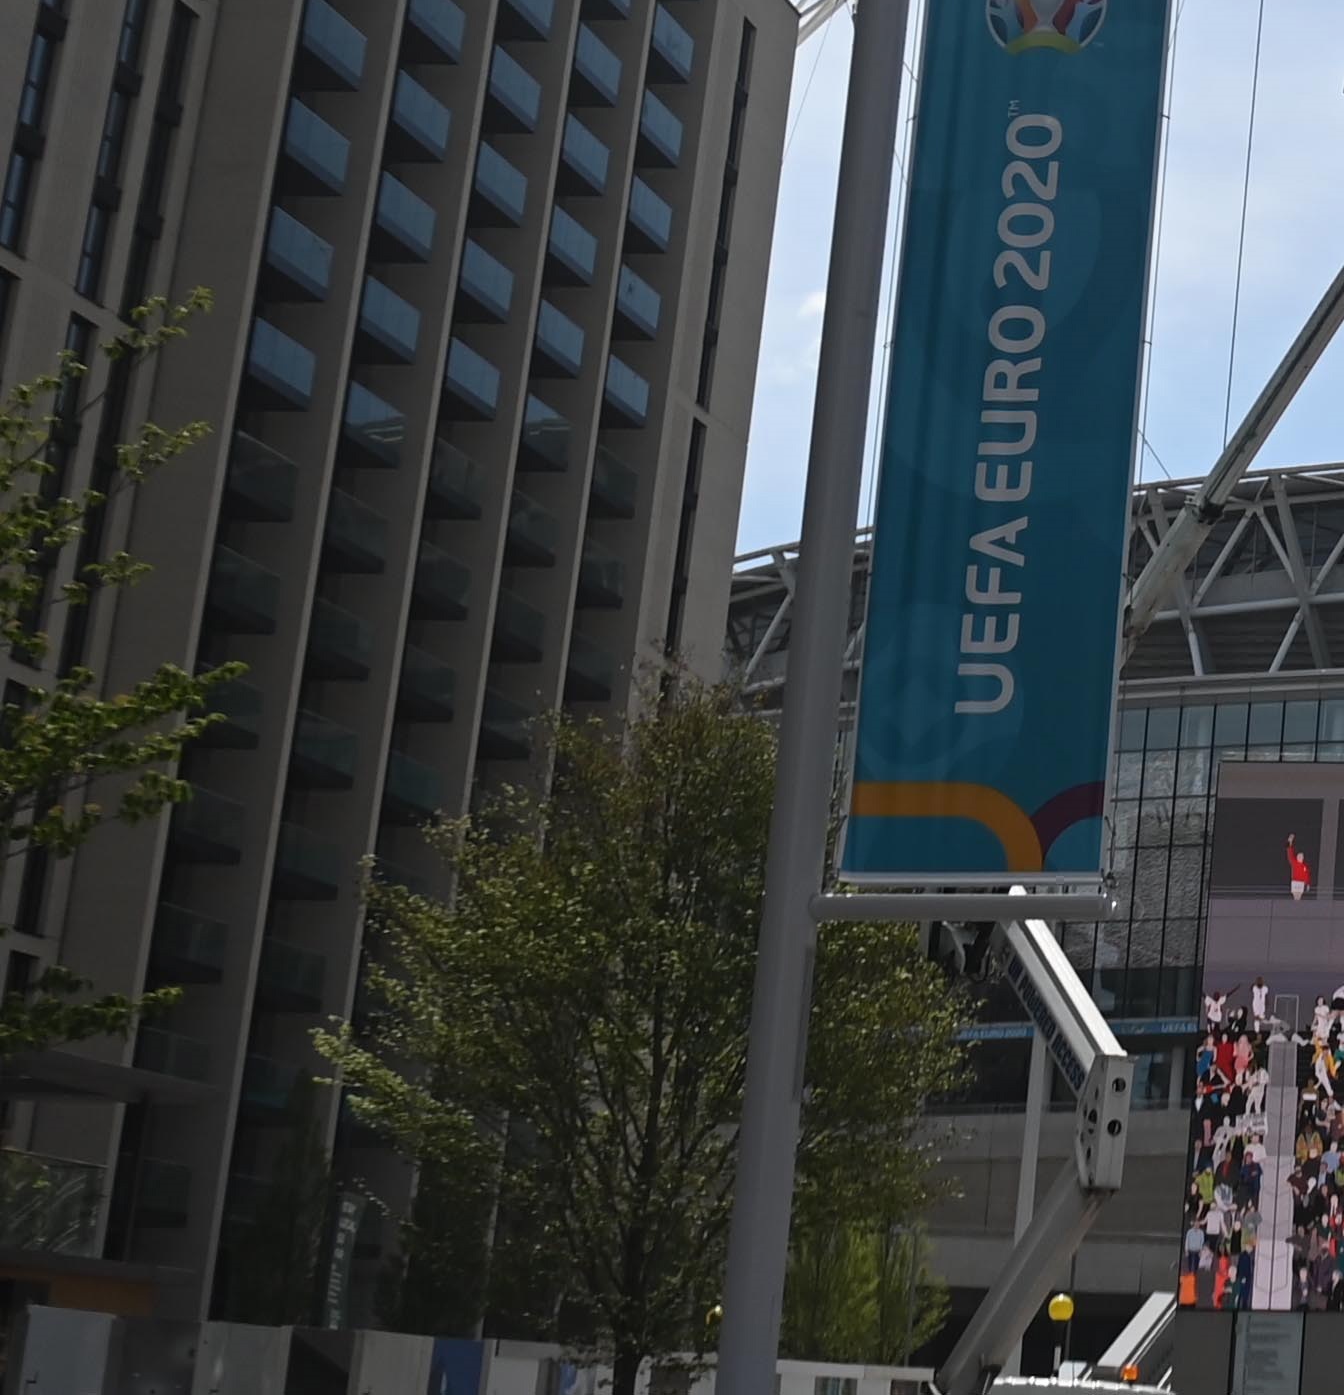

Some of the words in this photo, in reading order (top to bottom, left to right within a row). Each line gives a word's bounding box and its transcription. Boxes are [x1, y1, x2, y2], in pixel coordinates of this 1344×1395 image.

[974, 304, 1046, 503] EURO
[954, 516, 1029, 714] UEFA
[1051, 1032, 1089, 1091] ACCESS
